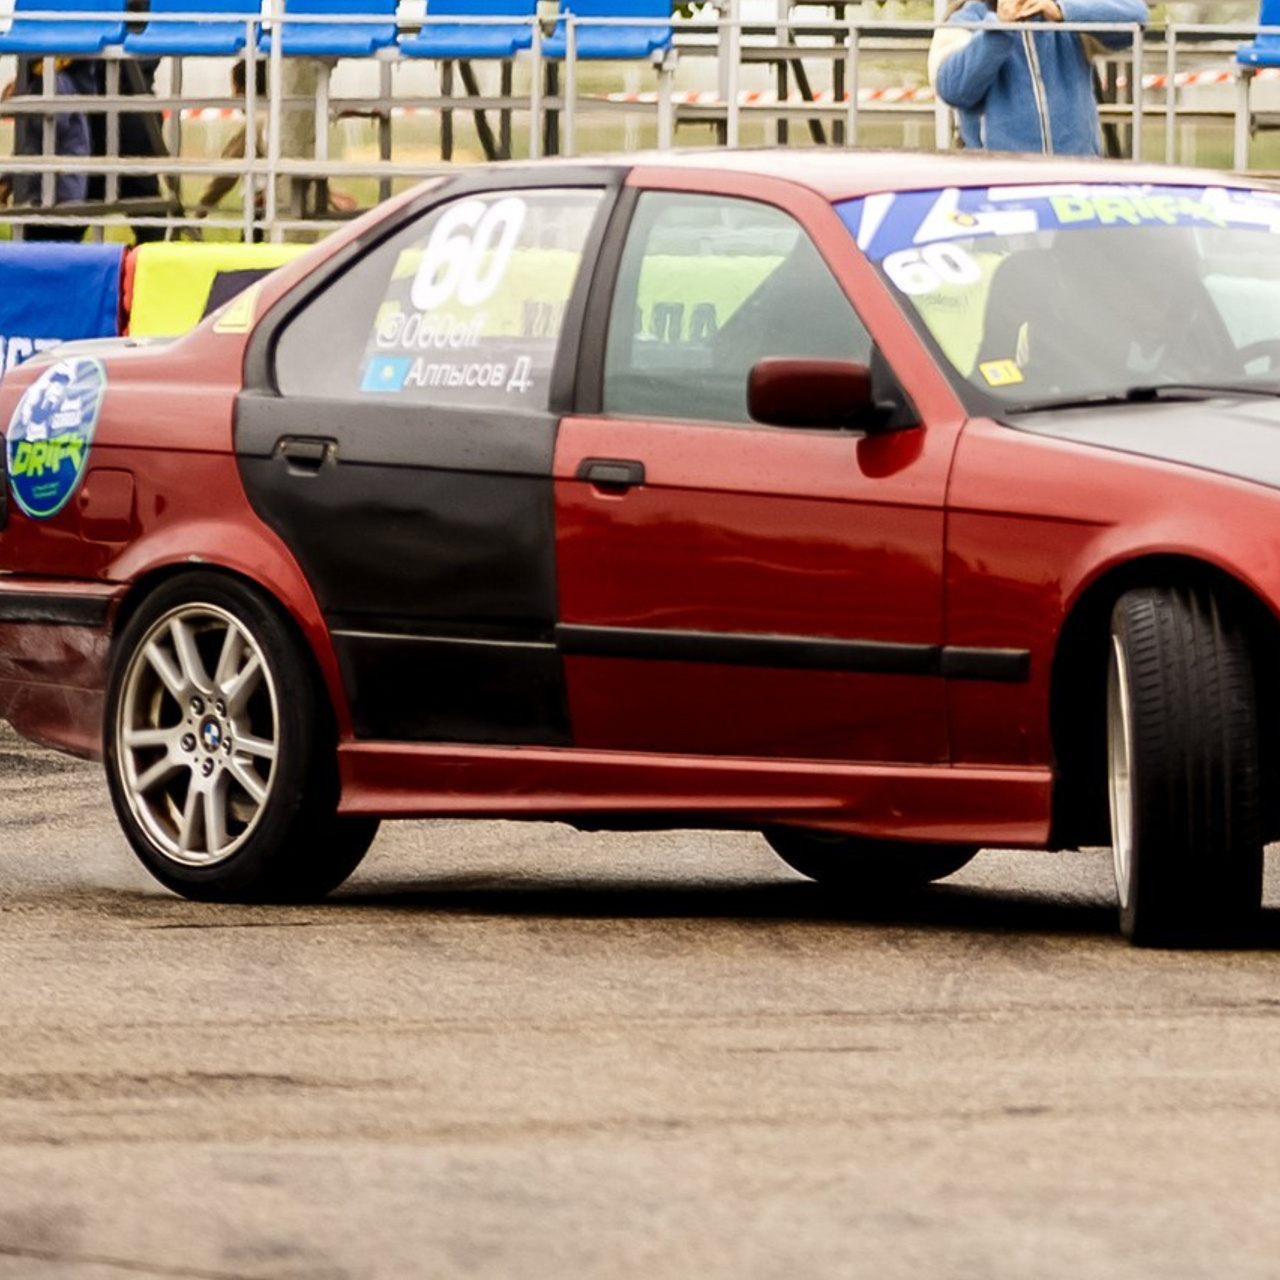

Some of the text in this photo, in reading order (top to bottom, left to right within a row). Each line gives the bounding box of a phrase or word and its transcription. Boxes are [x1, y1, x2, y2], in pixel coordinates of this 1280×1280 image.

[411, 197, 526, 310] 60
[882, 242, 981, 295] 60
[404, 355, 533, 393] Алпысов Д.
